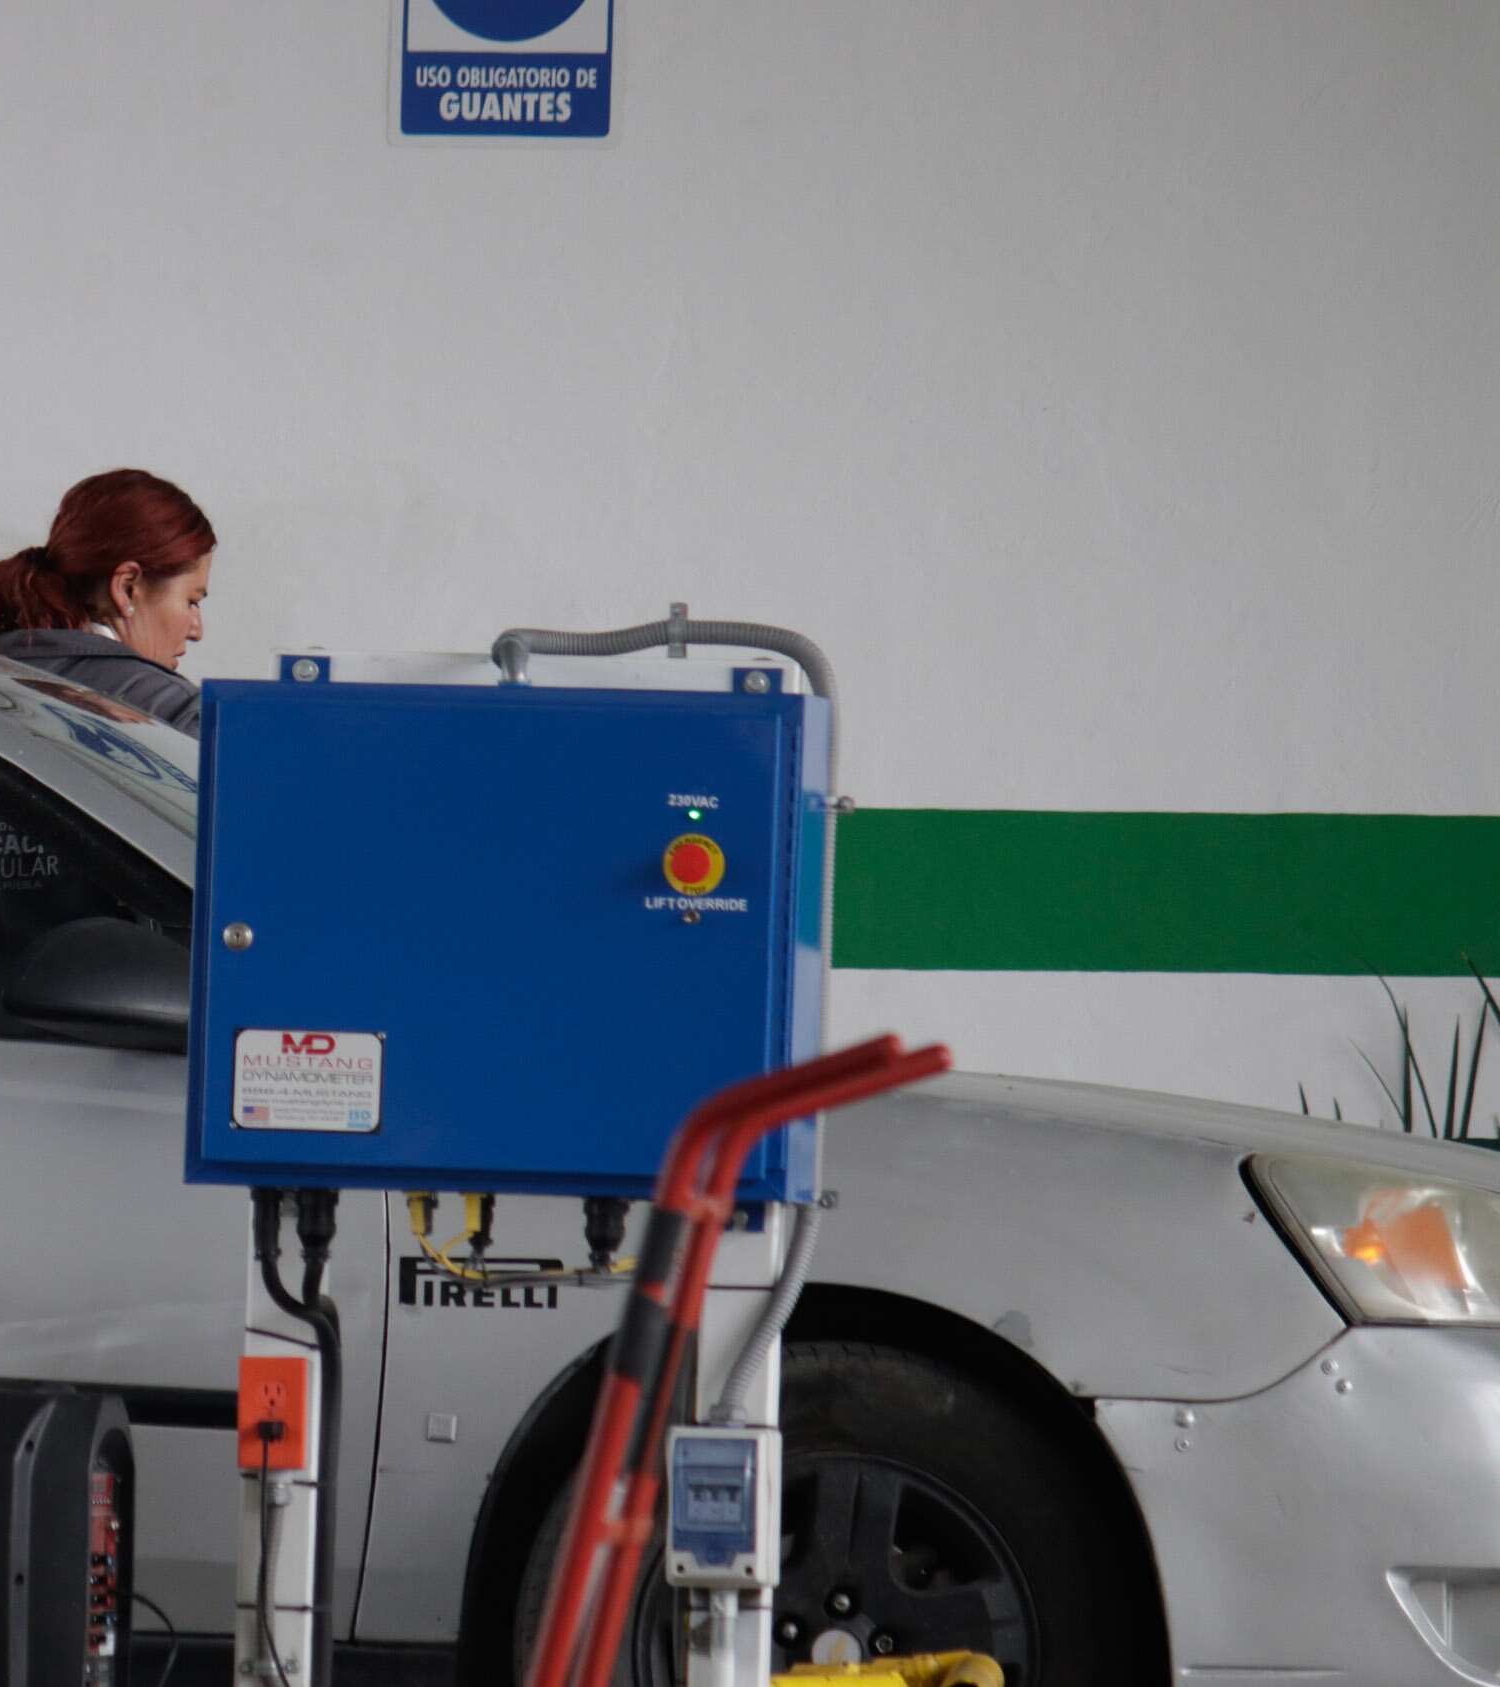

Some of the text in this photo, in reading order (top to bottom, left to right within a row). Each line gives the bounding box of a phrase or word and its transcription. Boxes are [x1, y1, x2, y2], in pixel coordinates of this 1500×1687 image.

[416, 66, 597, 89] USO OBLIGATORIO DE
[439, 92, 572, 122] GUANTES
[667, 794, 719, 808] 230VAC
[644, 897, 748, 912] LIFT OVERRIDE
[243, 1055, 373, 1070] MUSTANG
[242, 1070, 373, 1085] DYNAMOMETER
